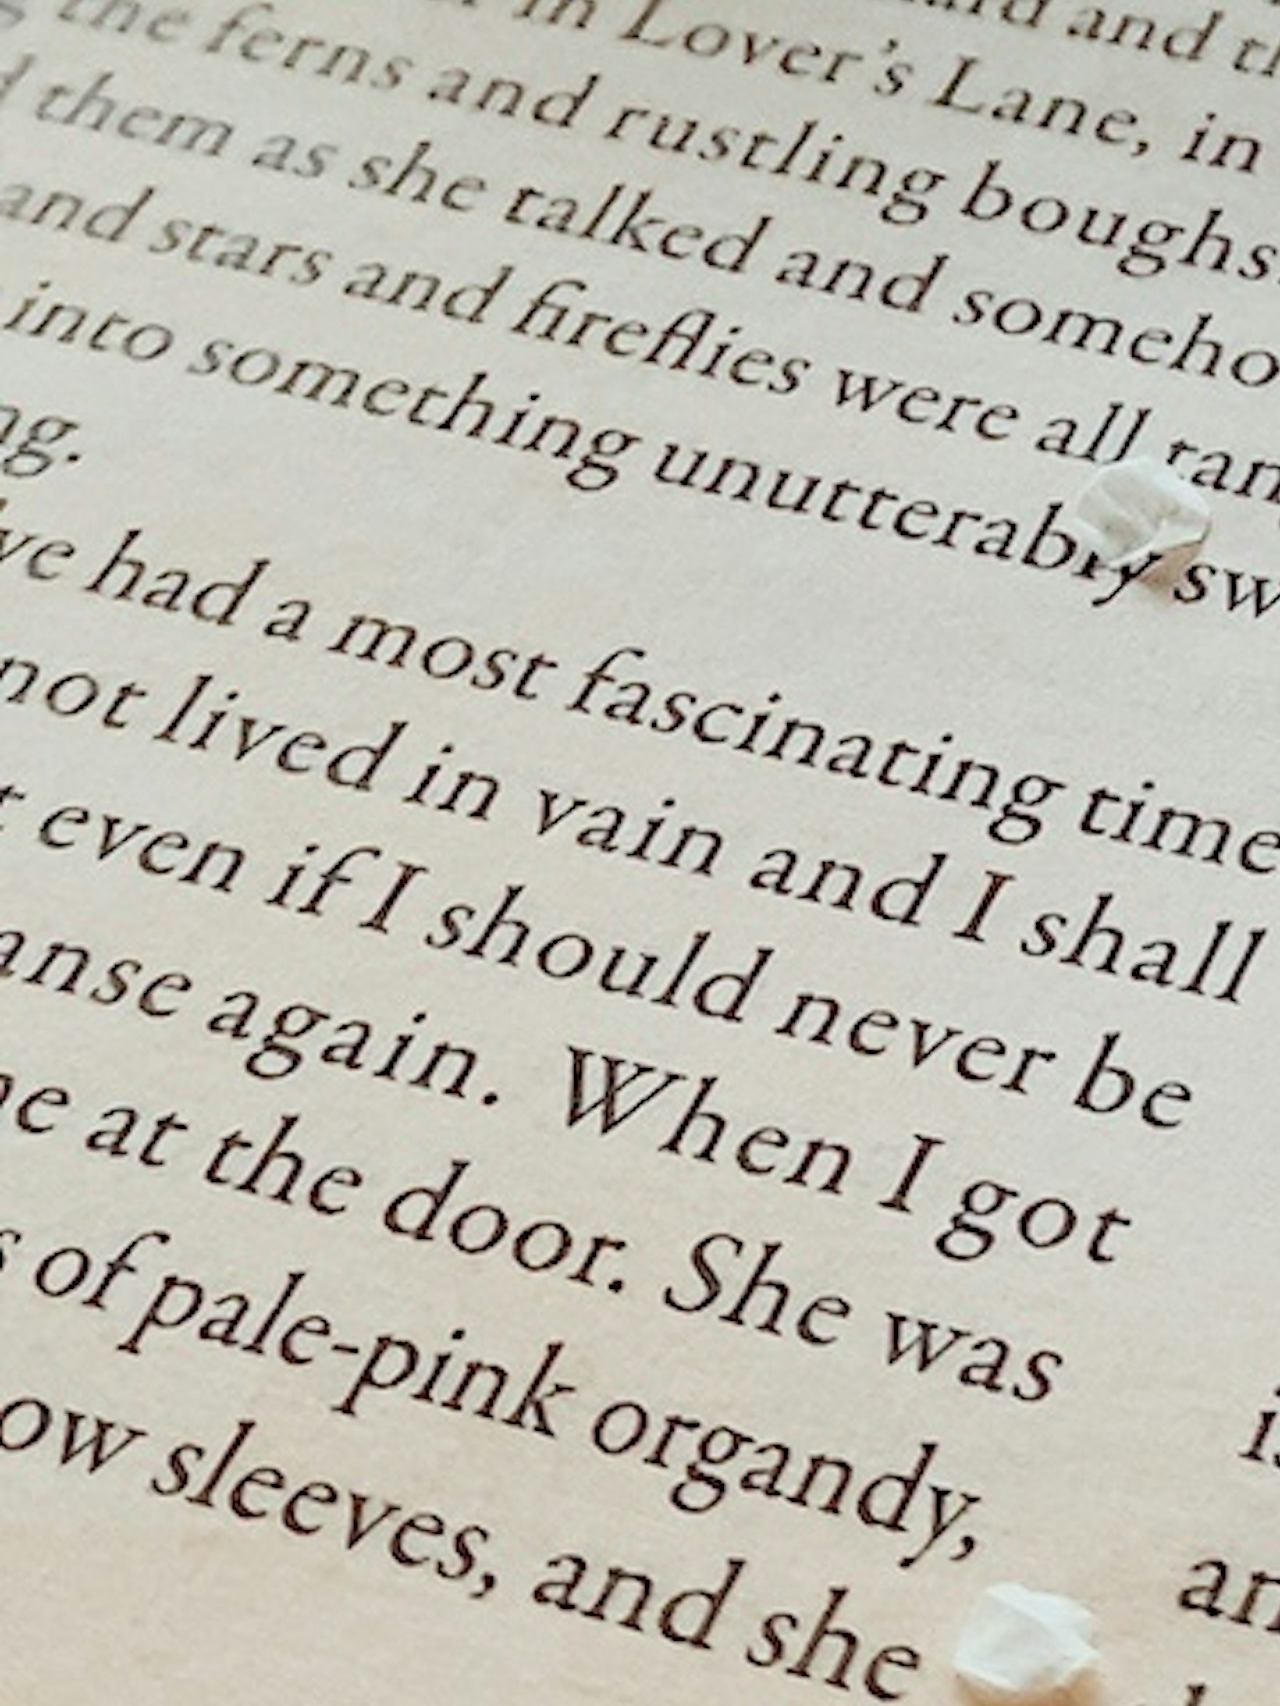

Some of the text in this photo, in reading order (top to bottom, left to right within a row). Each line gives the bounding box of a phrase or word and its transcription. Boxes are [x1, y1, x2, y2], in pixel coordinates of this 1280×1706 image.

[36, 73, 234, 156] them
[251, 137, 336, 177] as
[348, 140, 486, 212] she
[504, 183, 773, 274] talked
[775, 251, 950, 314] and
[927, 56, 1150, 158] Lane,
[1179, 111, 1263, 175] in
[3, 281, 174, 361] into
[188, 341, 642, 493] something
[83, 528, 271, 627] had
[263, 599, 312, 643] a
[326, 614, 559, 701] most
[565, 647, 1067, 846] fascinating
[38, 806, 1193, 1130] even if I should never be
[153, 674, 1268, 1004] lived in vain and I shall
[33, 1230, 982, 1570] of pale-pink organdy,
[85, 1106, 1064, 1403] at the door. She was
[149, 1419, 922, 1703] sleeves, and she
